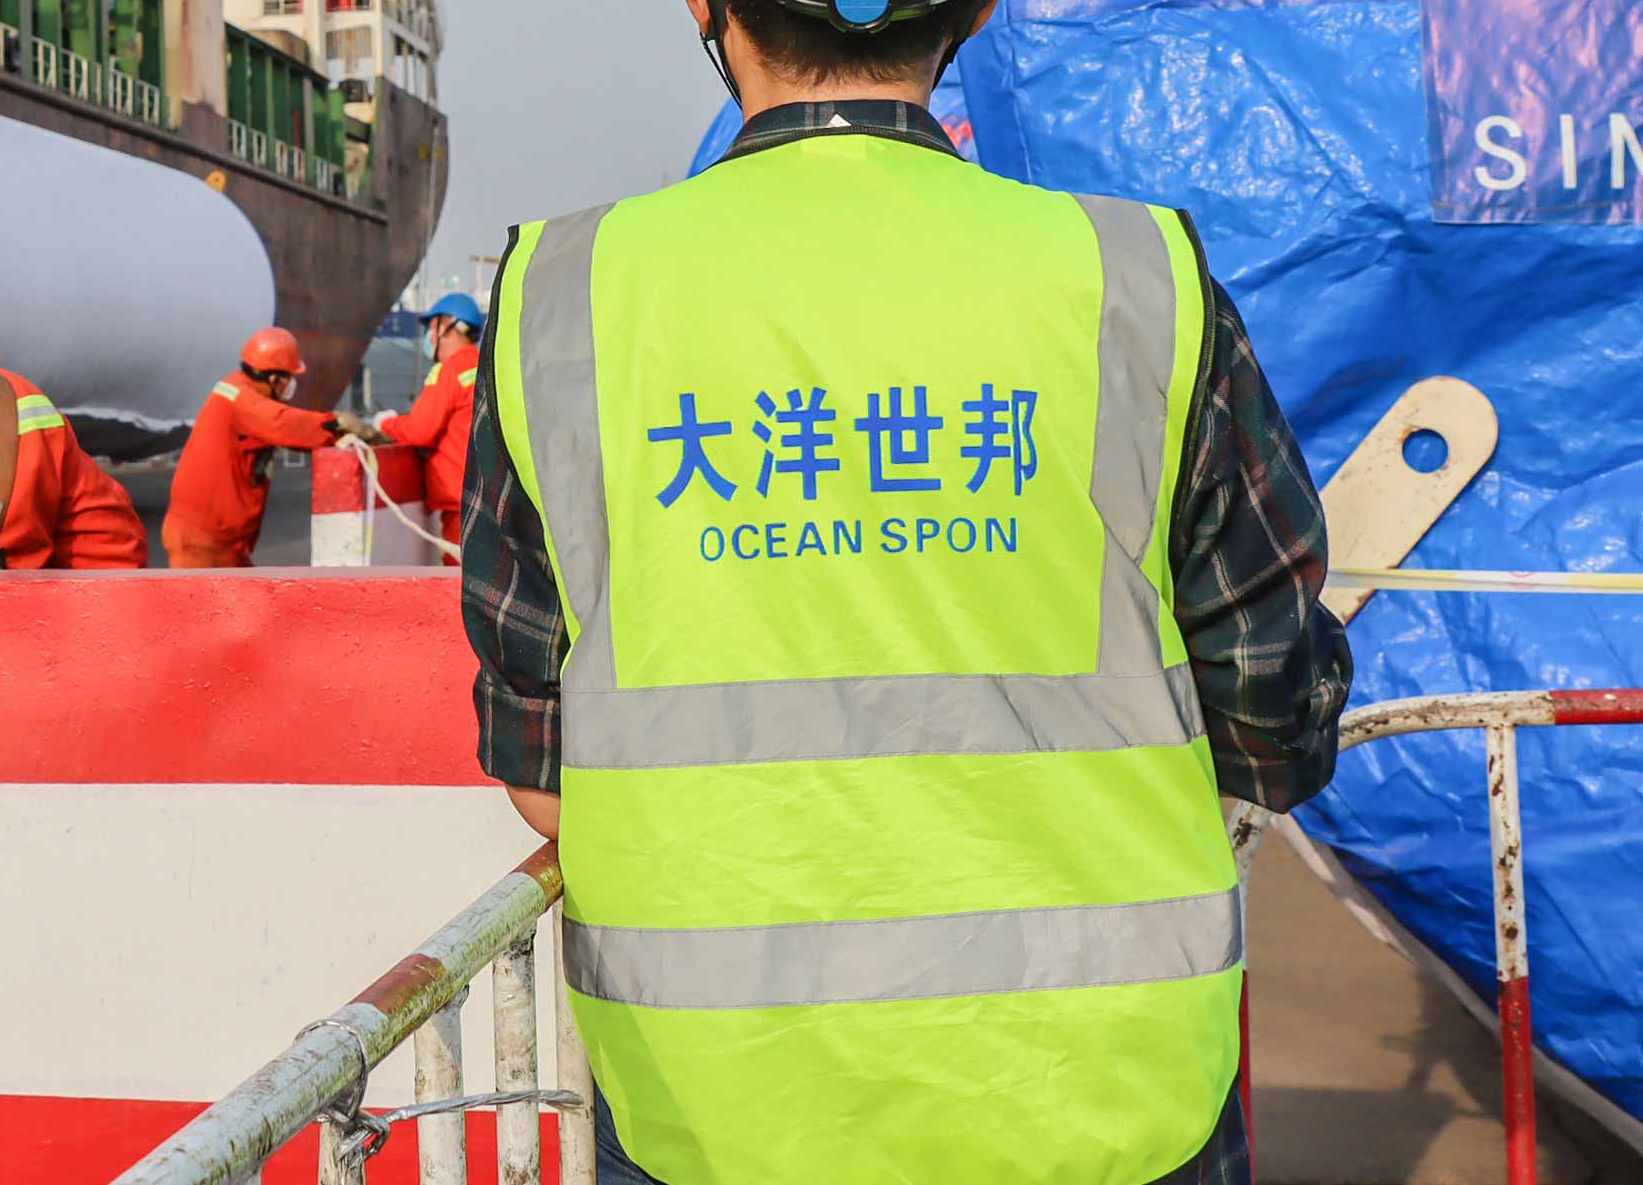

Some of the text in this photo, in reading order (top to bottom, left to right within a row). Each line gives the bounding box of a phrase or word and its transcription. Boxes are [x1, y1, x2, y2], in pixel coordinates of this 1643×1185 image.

[647, 383, 1038, 509] 大洋世邦
[700, 517, 1018, 562] OCEAN SPON
